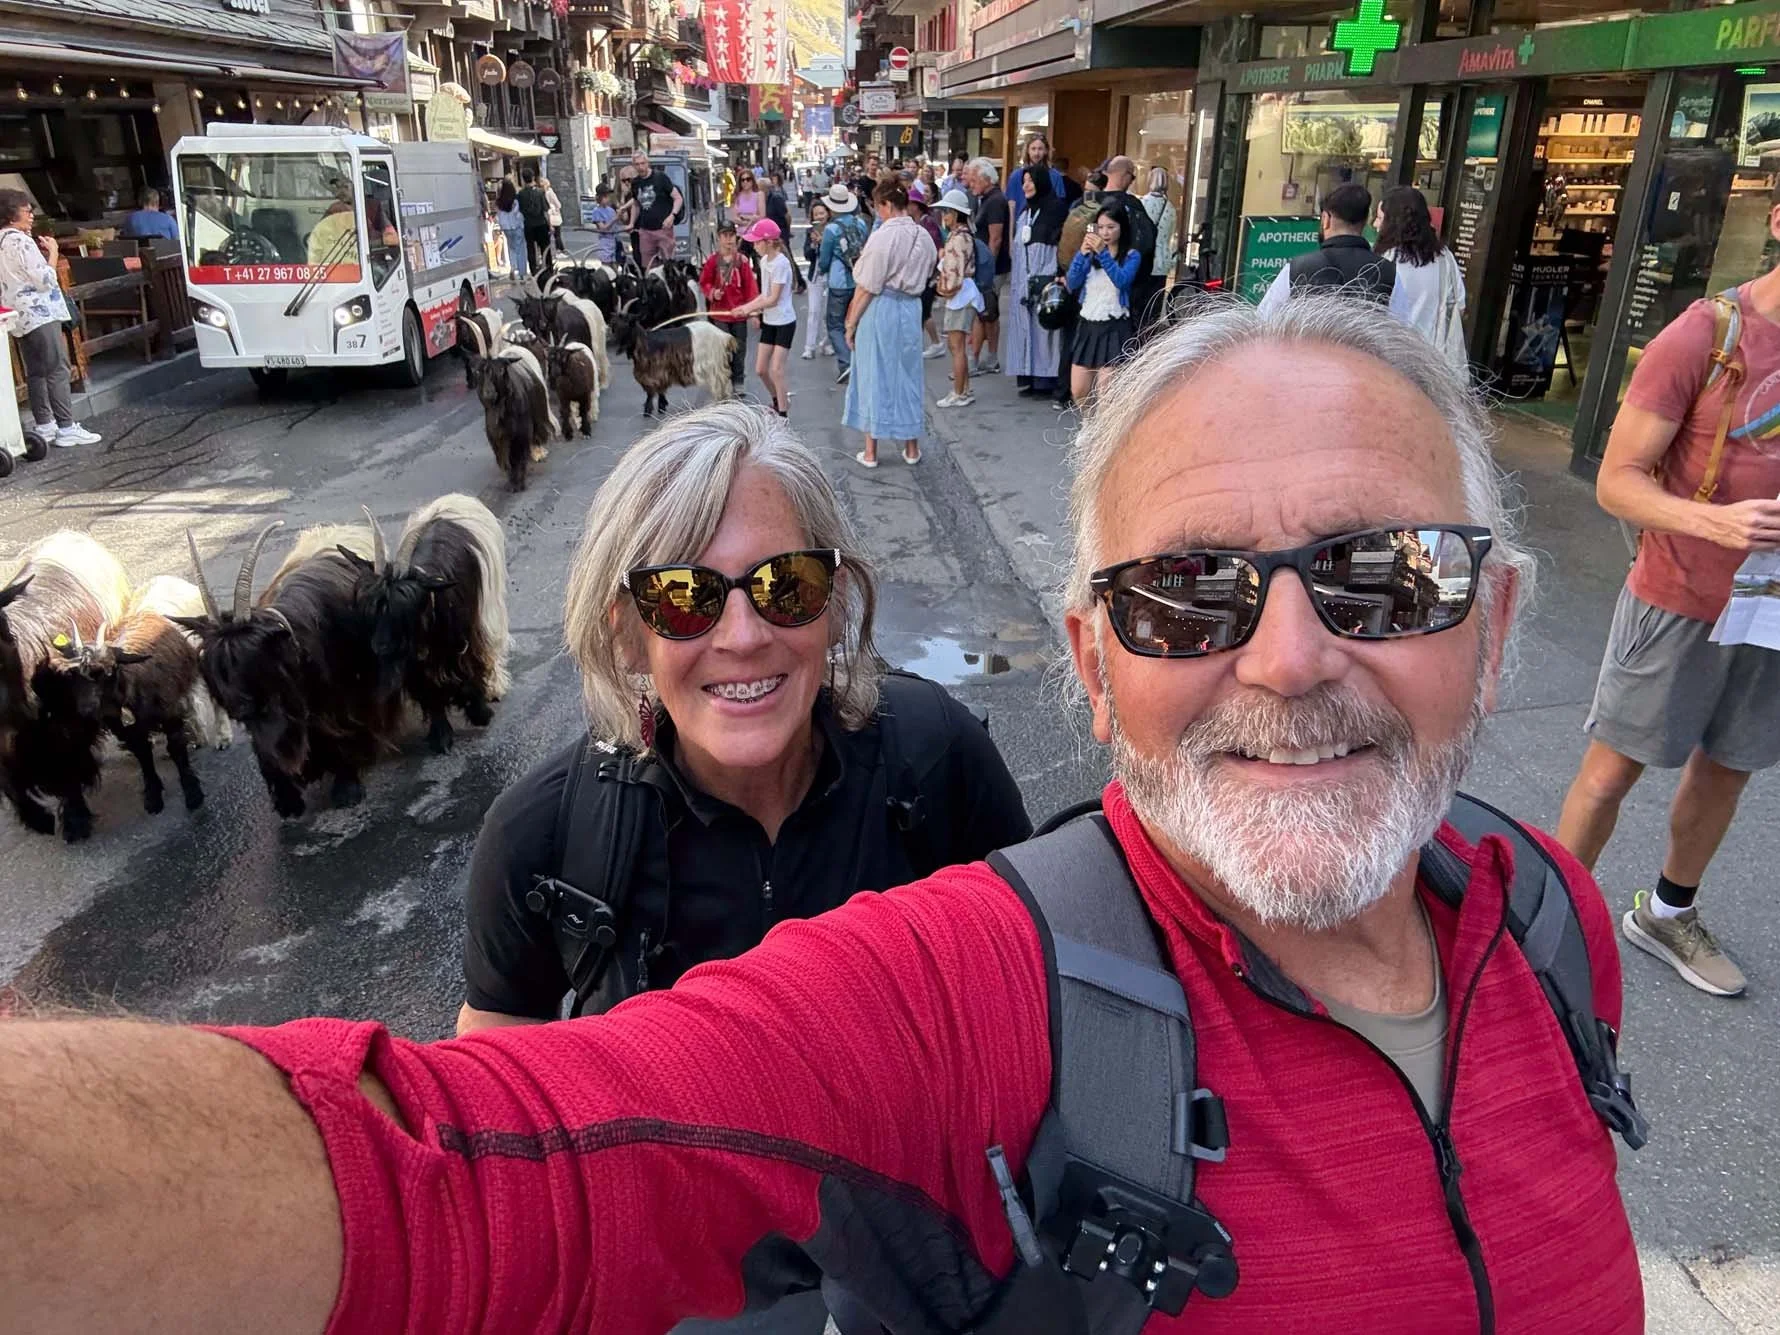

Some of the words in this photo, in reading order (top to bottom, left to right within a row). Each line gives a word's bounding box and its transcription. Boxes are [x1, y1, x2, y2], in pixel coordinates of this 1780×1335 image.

[1241, 66, 1290, 85] APOTHEKE
[1258, 232, 1319, 243] APOTHEKE
[224, 268, 231, 280] T
[235, 268, 254, 280] +41
[258, 268, 271, 280] 27
[274, 268, 293, 280] 967
[297, 267, 311, 280] 08
